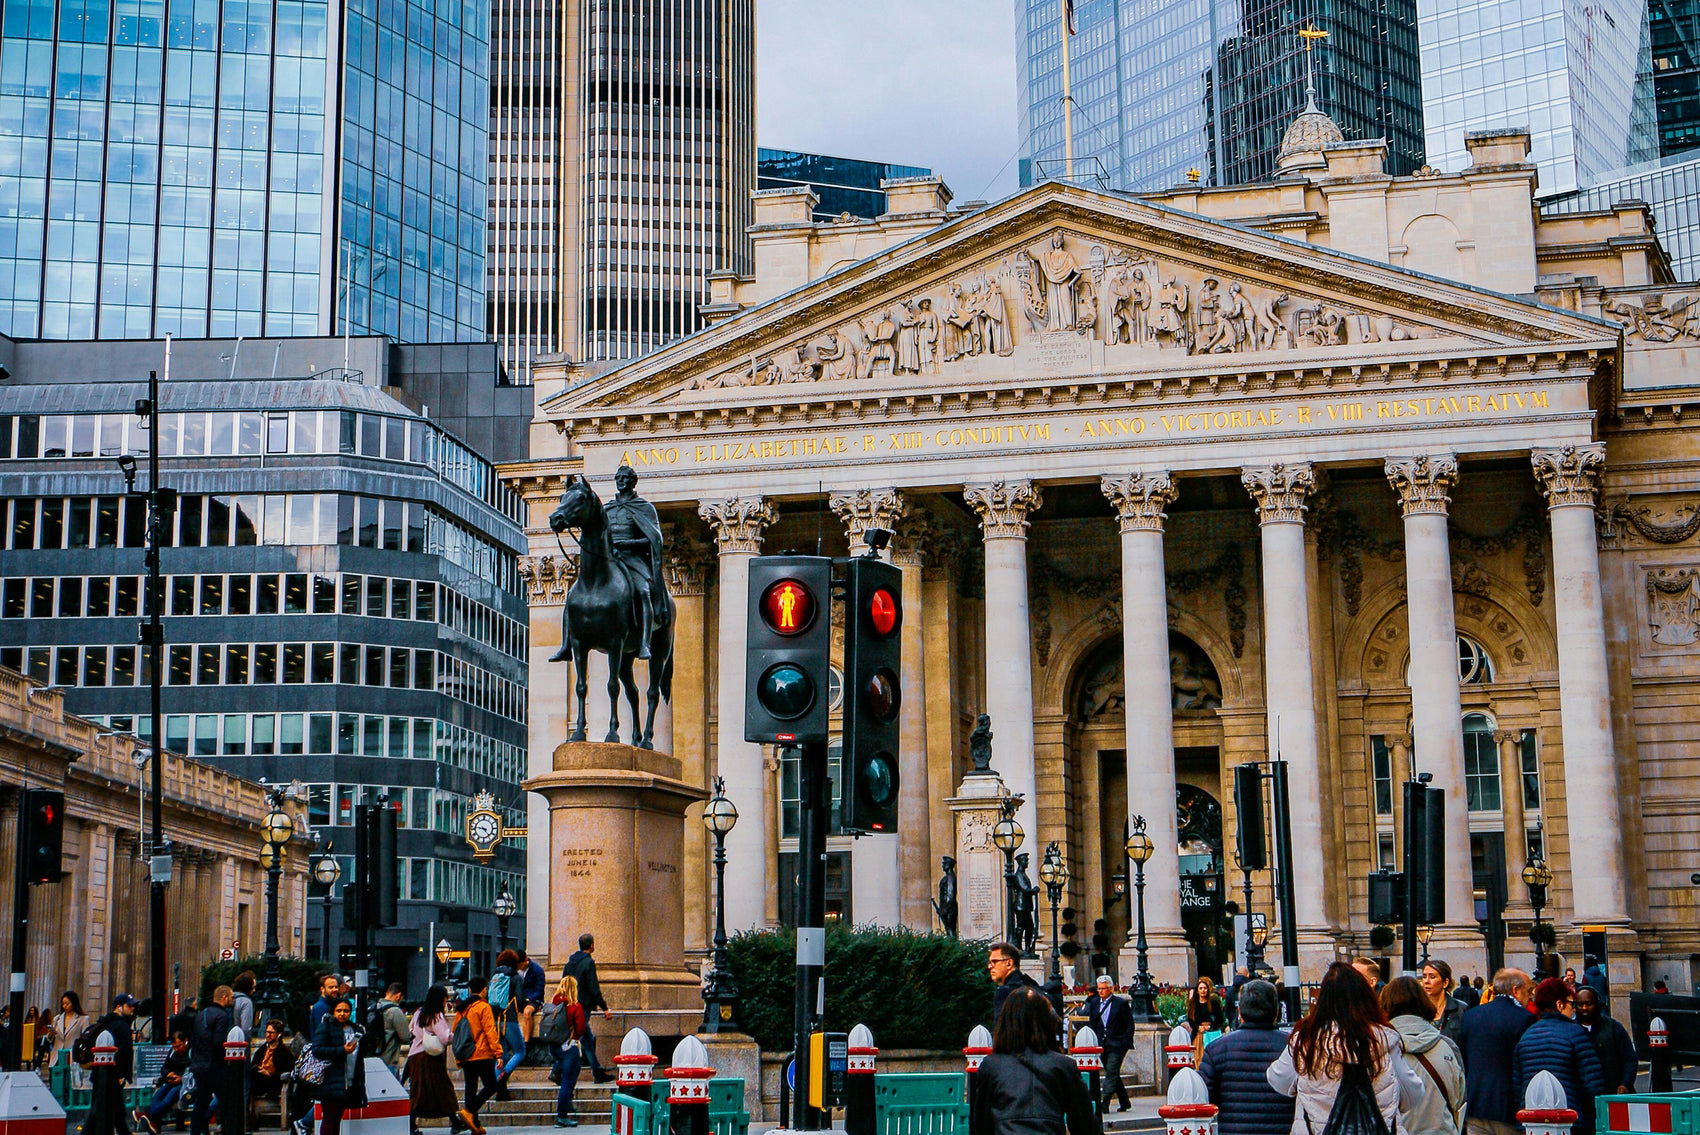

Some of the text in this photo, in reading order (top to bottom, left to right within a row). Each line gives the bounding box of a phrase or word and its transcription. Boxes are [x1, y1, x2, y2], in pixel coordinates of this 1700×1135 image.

[618, 390, 1550, 467] ANNO ELIZABETHAE R XIII CONDITVM ANNO VICTORIAE R VIII RESTAVRATVM
[562, 848, 603, 856] ERECTED
